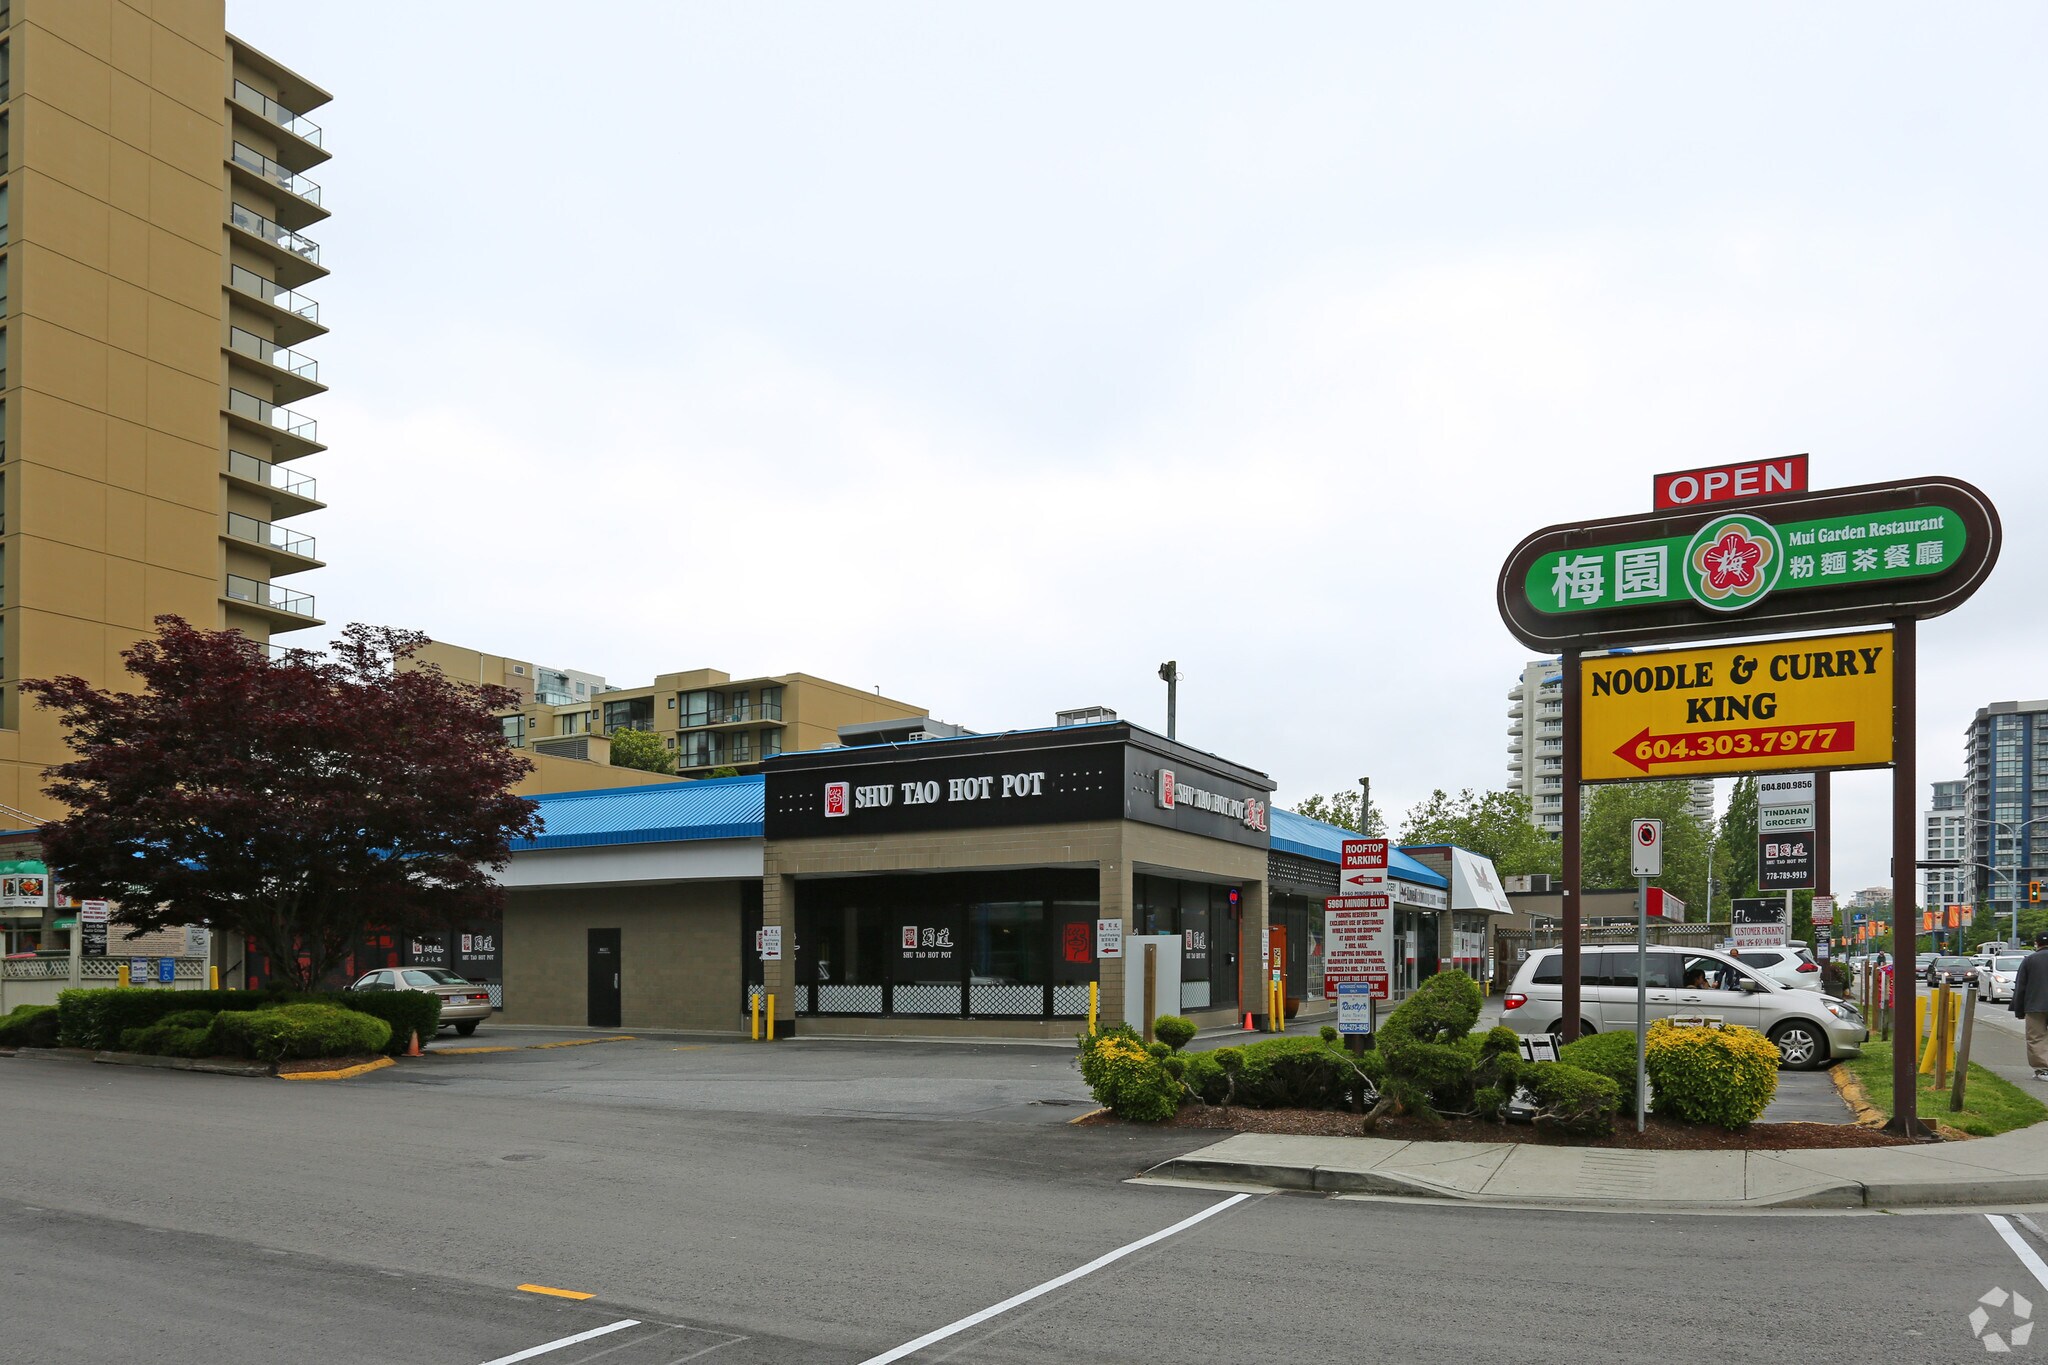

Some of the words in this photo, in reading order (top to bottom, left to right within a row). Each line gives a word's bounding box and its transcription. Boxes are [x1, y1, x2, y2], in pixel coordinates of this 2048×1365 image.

[1668, 462, 1792, 504] OPEN
[1789, 528, 1815, 546] Mui
[1817, 525, 1866, 543] Garden
[1869, 515, 1944, 537] Restaurant
[1789, 540, 1944, 579] 粉麵茶餐廳
[1551, 545, 1668, 608] 梅園
[1591, 661, 1713, 696] NOODLE
[1729, 654, 1758, 685] &
[1769, 647, 1883, 682] CURRY
[1686, 692, 1777, 723] KING
[1635, 728, 1838, 760] 604.303.7977
[855, 784, 895, 809] SHU
[901, 780, 940, 805] TAO
[948, 776, 994, 802] HOT
[1001, 771, 1045, 798] POT
[1761, 780, 1812, 792] 604.800.9856
[1177, 783, 1194, 806] SHU
[1196, 788, 1211, 810] TAO
[1212, 794, 1229, 815] HOT
[1230, 799, 1245, 820] POT
[1764, 807, 1809, 817] TINDAHAN
[1765, 817, 1807, 827] GROCERY
[1346, 844, 1384, 853] ROOFTOP
[1347, 856, 1382, 865] PARKING
[1327, 899, 1343, 909] 5960
[1344, 898, 1369, 908] MINORU
[1370, 897, 1387, 907] BLVD.
[1734, 926, 1761, 936] CUSTOMER
[1761, 926, 1784, 935] PARKING
[903, 951, 914, 959] SHU
[915, 951, 926, 959] TAO
[927, 951, 939, 959] HOT
[941, 951, 952, 959] POT
[1341, 1001, 1367, 1012] Rusty's
